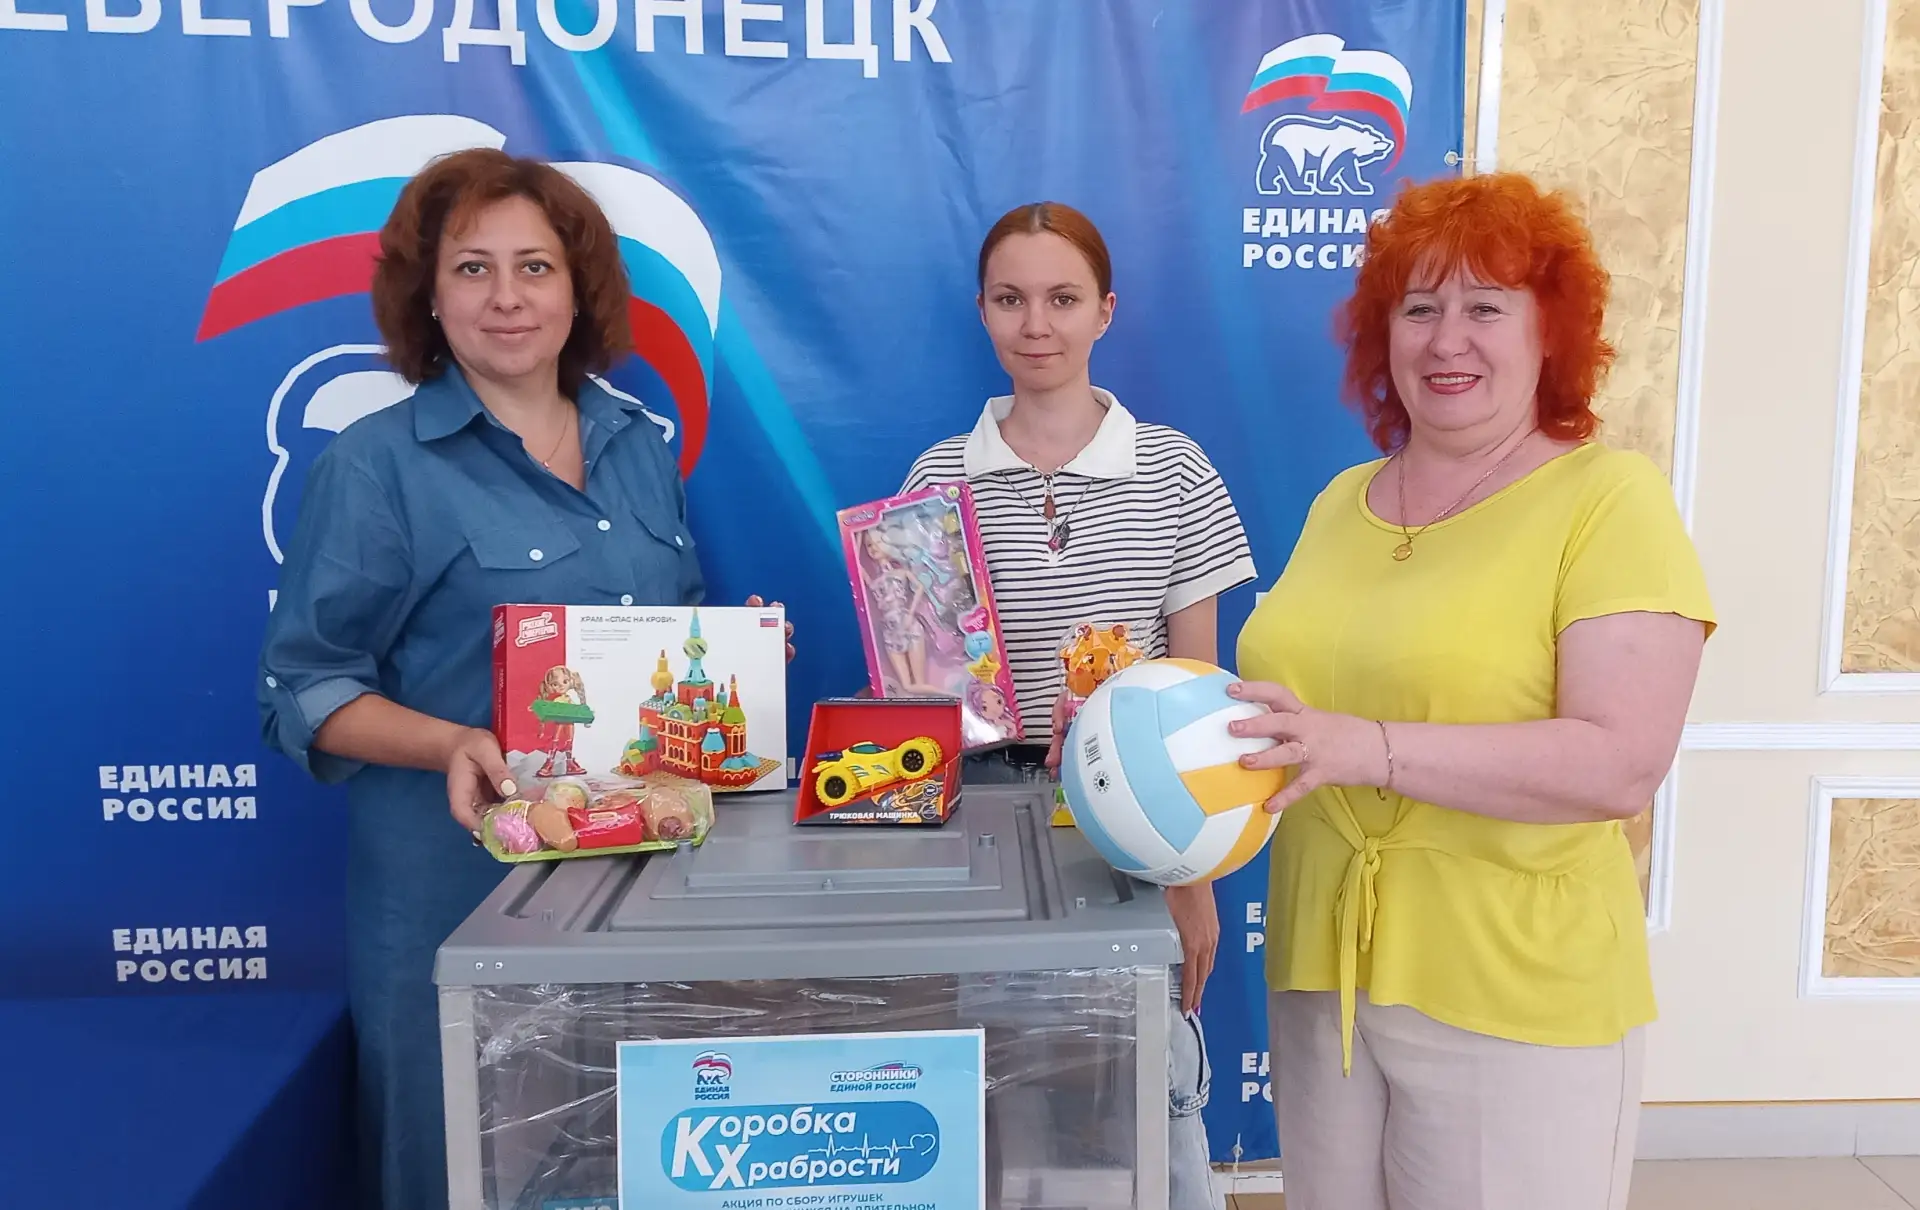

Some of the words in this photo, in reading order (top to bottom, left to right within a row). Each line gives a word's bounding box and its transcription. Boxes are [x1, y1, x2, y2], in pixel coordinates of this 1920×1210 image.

[1243, 243, 1365, 269] РОССИ
[99, 764, 257, 793] ЕДИНАЯ
[102, 796, 257, 822] РОССИЯ
[829, 812, 874, 820] ТРЮКОВАЯ
[875, 811, 919, 820] МАШИНКА
[112, 926, 268, 955] ЕДИНАЯ
[116, 957, 268, 983] РОССИЯ
[830, 1068, 917, 1083] СТОРОННИКИ
[830, 1082, 873, 1093] ЕДИНОЙ
[875, 1082, 916, 1091] РОССИИ
[694, 1086, 730, 1094] ЕДИНАЯ
[694, 1093, 730, 1101] РОССИЯ
[671, 1106, 857, 1178] Коробка
[708, 1154, 901, 1190] Храбрости
[722, 1199, 763, 1209] АКЦИЯ
[766, 1197, 784, 1207] ПО
[786, 1195, 825, 1206] СБОРУ
[828, 1193, 883, 1204] ИГРУШЕК
